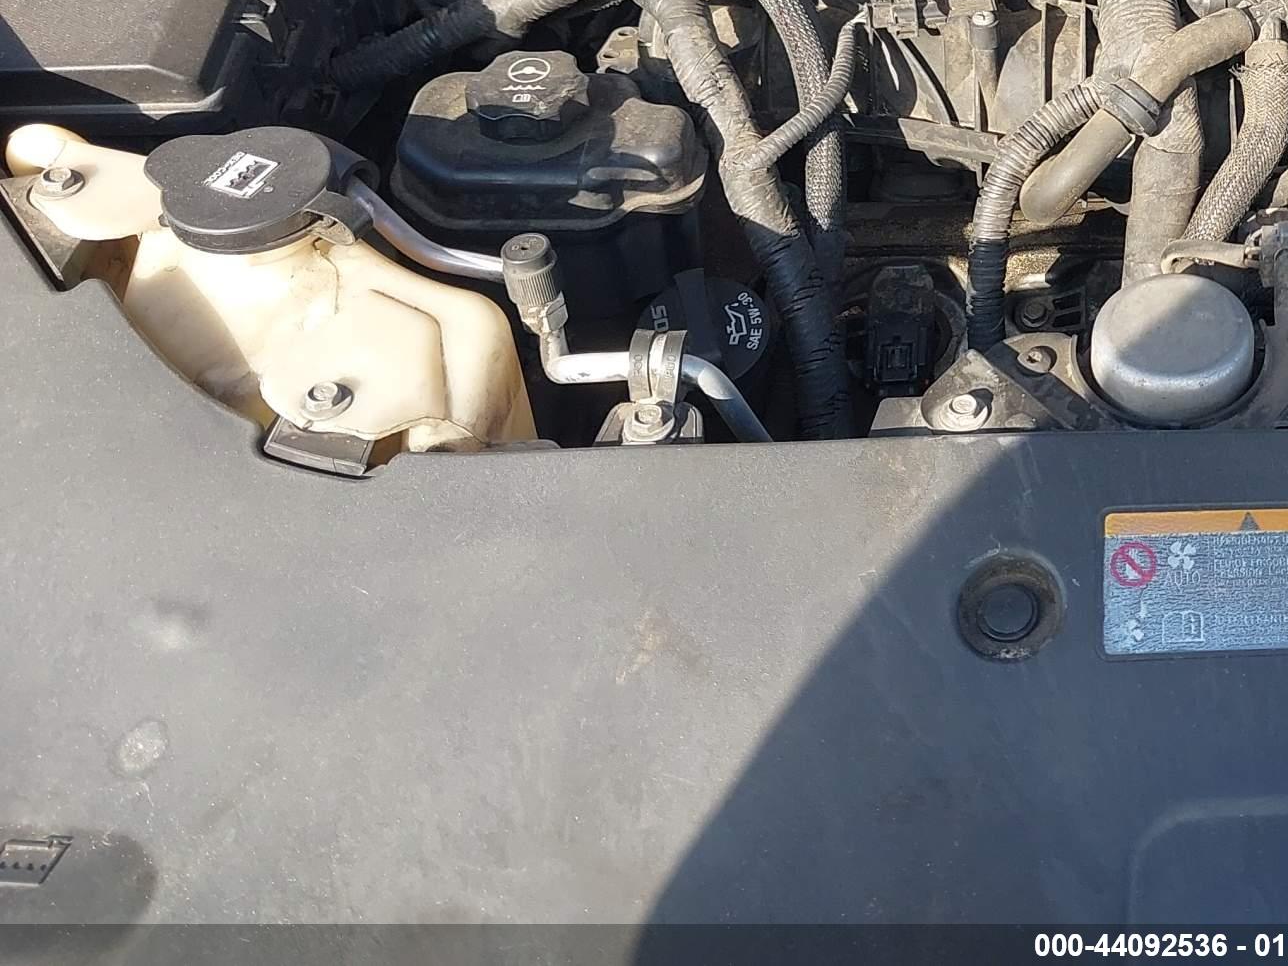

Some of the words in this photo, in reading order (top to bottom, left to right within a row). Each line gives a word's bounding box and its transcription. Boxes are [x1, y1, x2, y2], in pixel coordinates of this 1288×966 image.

[737, 292, 763, 325] 5W-30
[747, 328, 763, 350] SAE
[1164, 571, 1201, 587] AUTO
